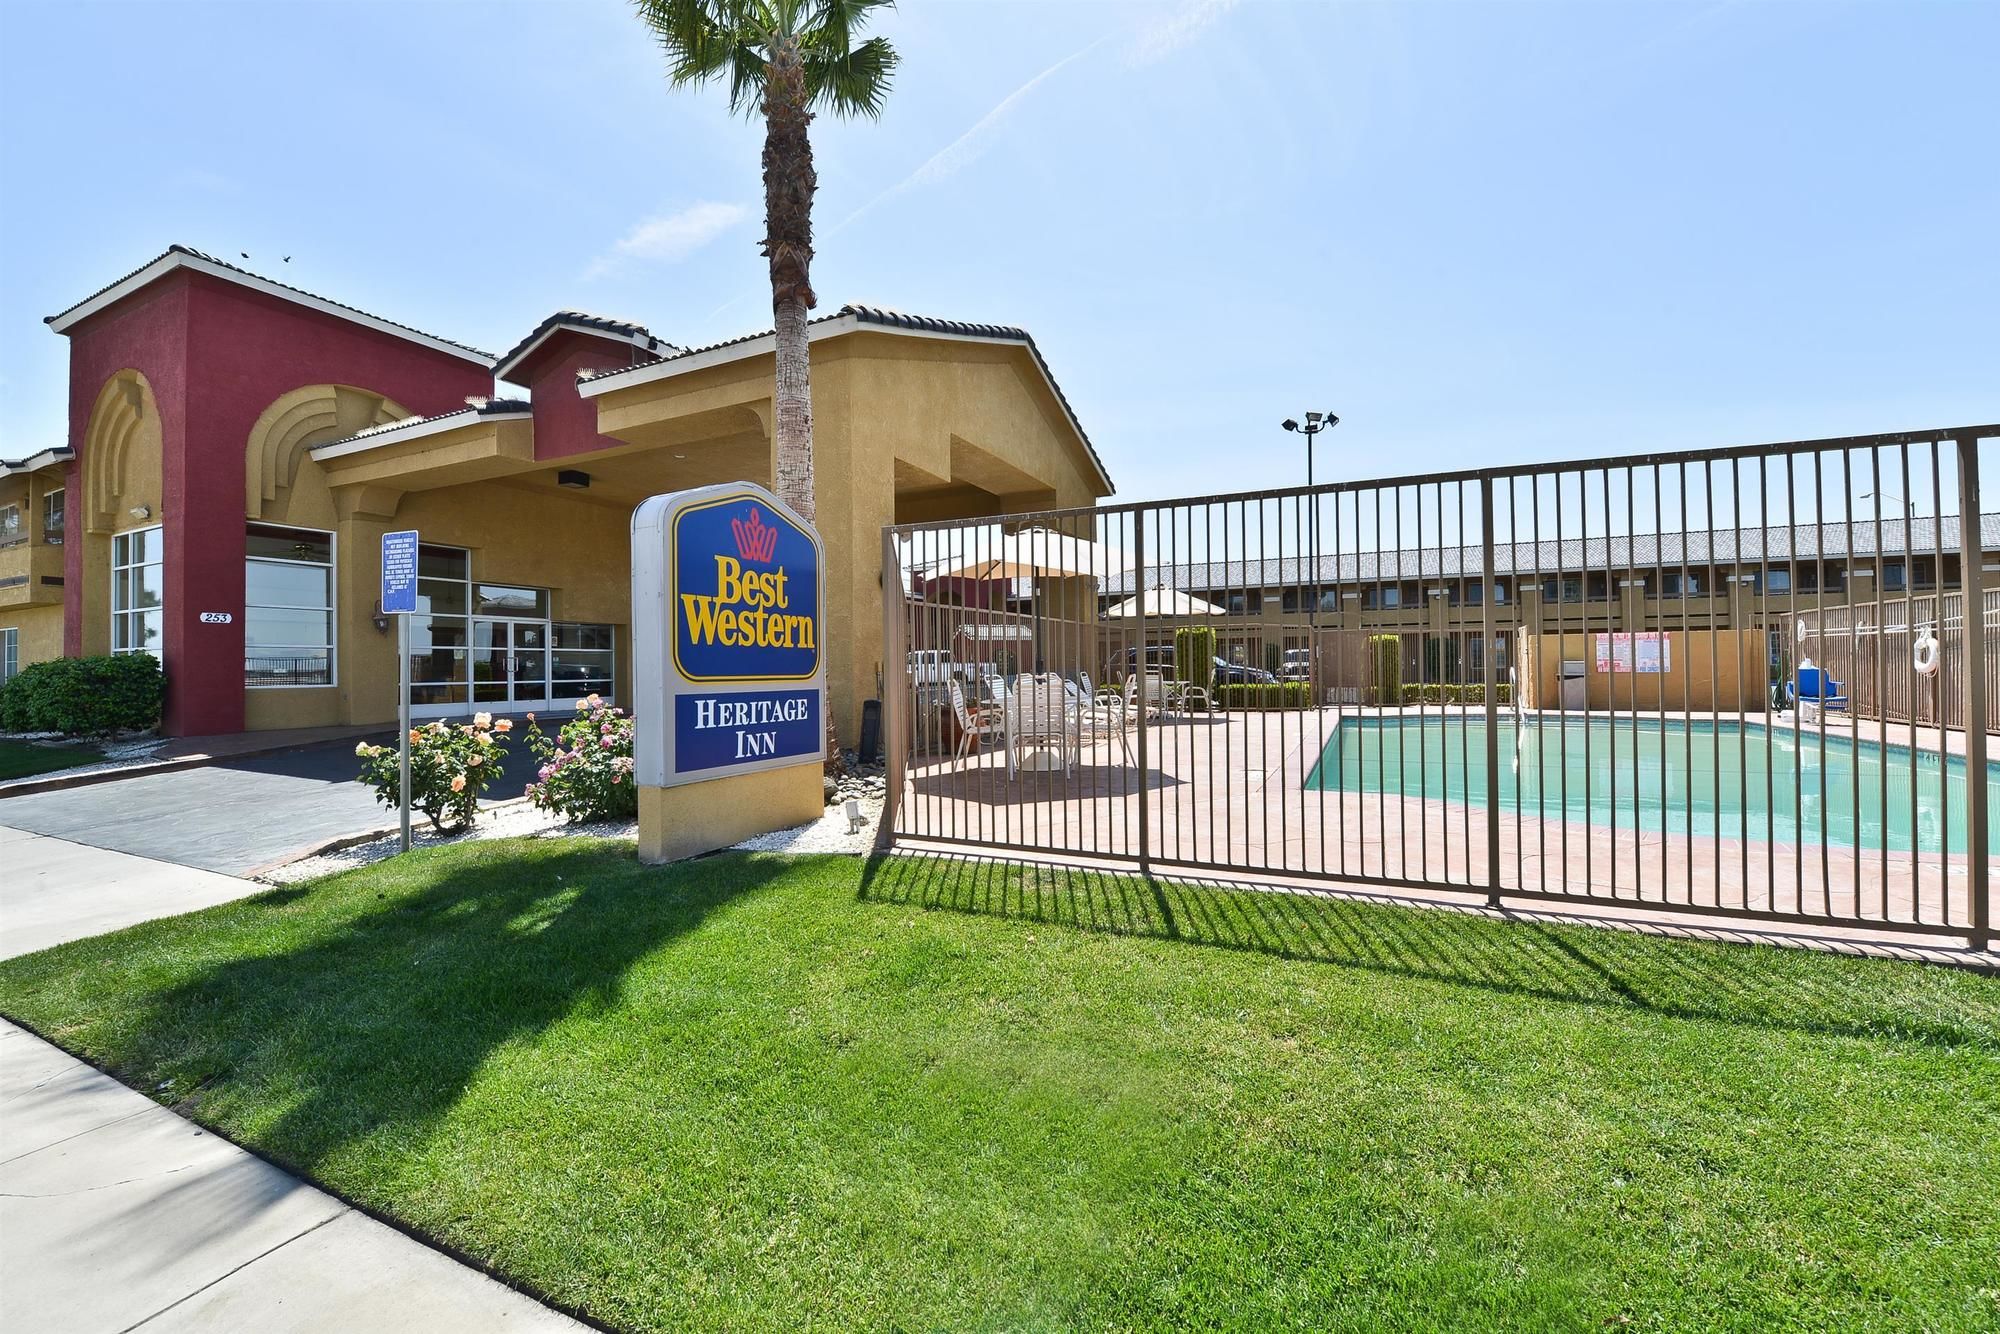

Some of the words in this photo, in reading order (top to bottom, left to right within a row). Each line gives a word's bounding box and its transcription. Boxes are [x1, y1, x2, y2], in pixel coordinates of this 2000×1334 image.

[714, 554, 788, 609] Best
[205, 613, 228, 623] 253
[680, 593, 815, 649] Western
[694, 698, 808, 729] HERITAGE
[735, 730, 777, 759] INN
